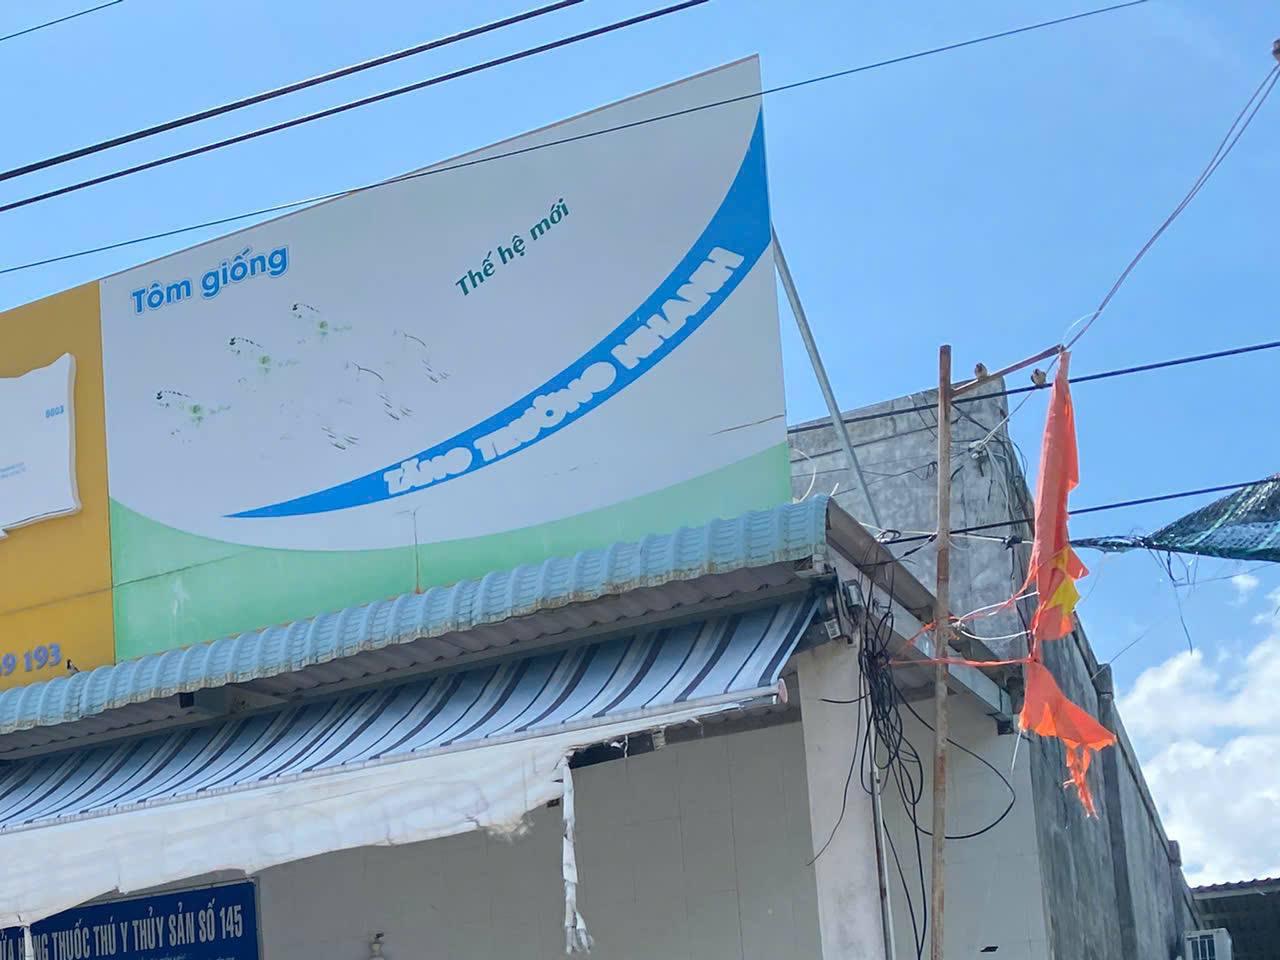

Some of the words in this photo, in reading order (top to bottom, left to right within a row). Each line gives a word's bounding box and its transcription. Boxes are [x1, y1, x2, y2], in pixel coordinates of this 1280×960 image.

[456, 252, 495, 295] Thế
[497, 235, 525, 265] hệ
[530, 197, 569, 240] mới
[132, 279, 191, 314] Tôm
[201, 246, 289, 298] giống
[24, 643, 62, 673] 193
[93, 915, 116, 957] THÚ
[120, 921, 130, 952] Y
[132, 906, 164, 951] THỦY
[169, 901, 195, 947] SẢN
[198, 899, 217, 942] SỐ
[220, 904, 243, 940] 145
